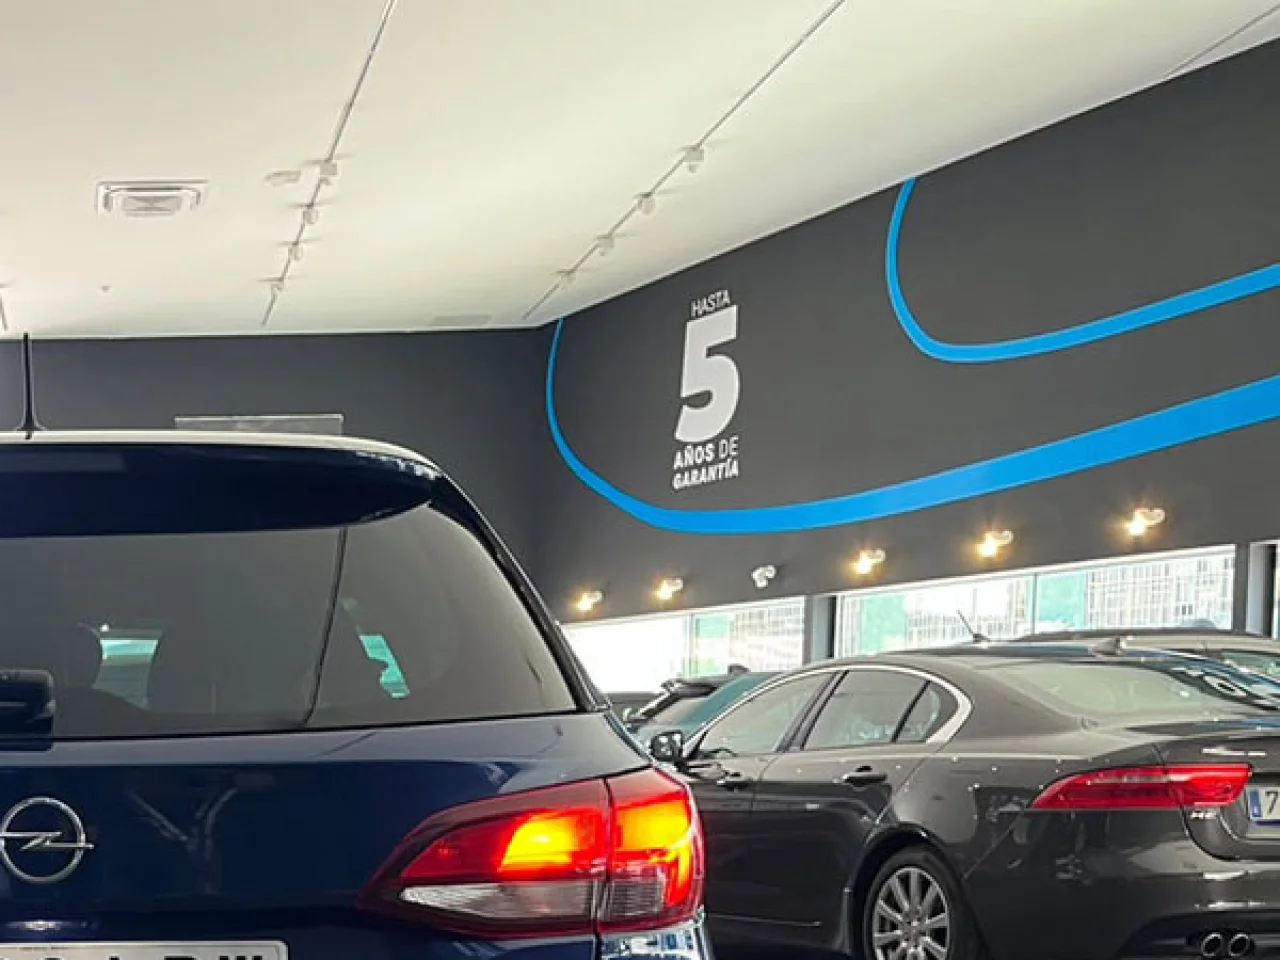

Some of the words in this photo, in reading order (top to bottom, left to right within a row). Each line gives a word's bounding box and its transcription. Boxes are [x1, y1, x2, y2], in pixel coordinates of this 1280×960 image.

[691, 289, 731, 317] HASTA
[674, 304, 740, 442] 5
[673, 442, 715, 470] AÑOS
[719, 435, 739, 459] DE
[673, 456, 739, 490] GARANTÍA
